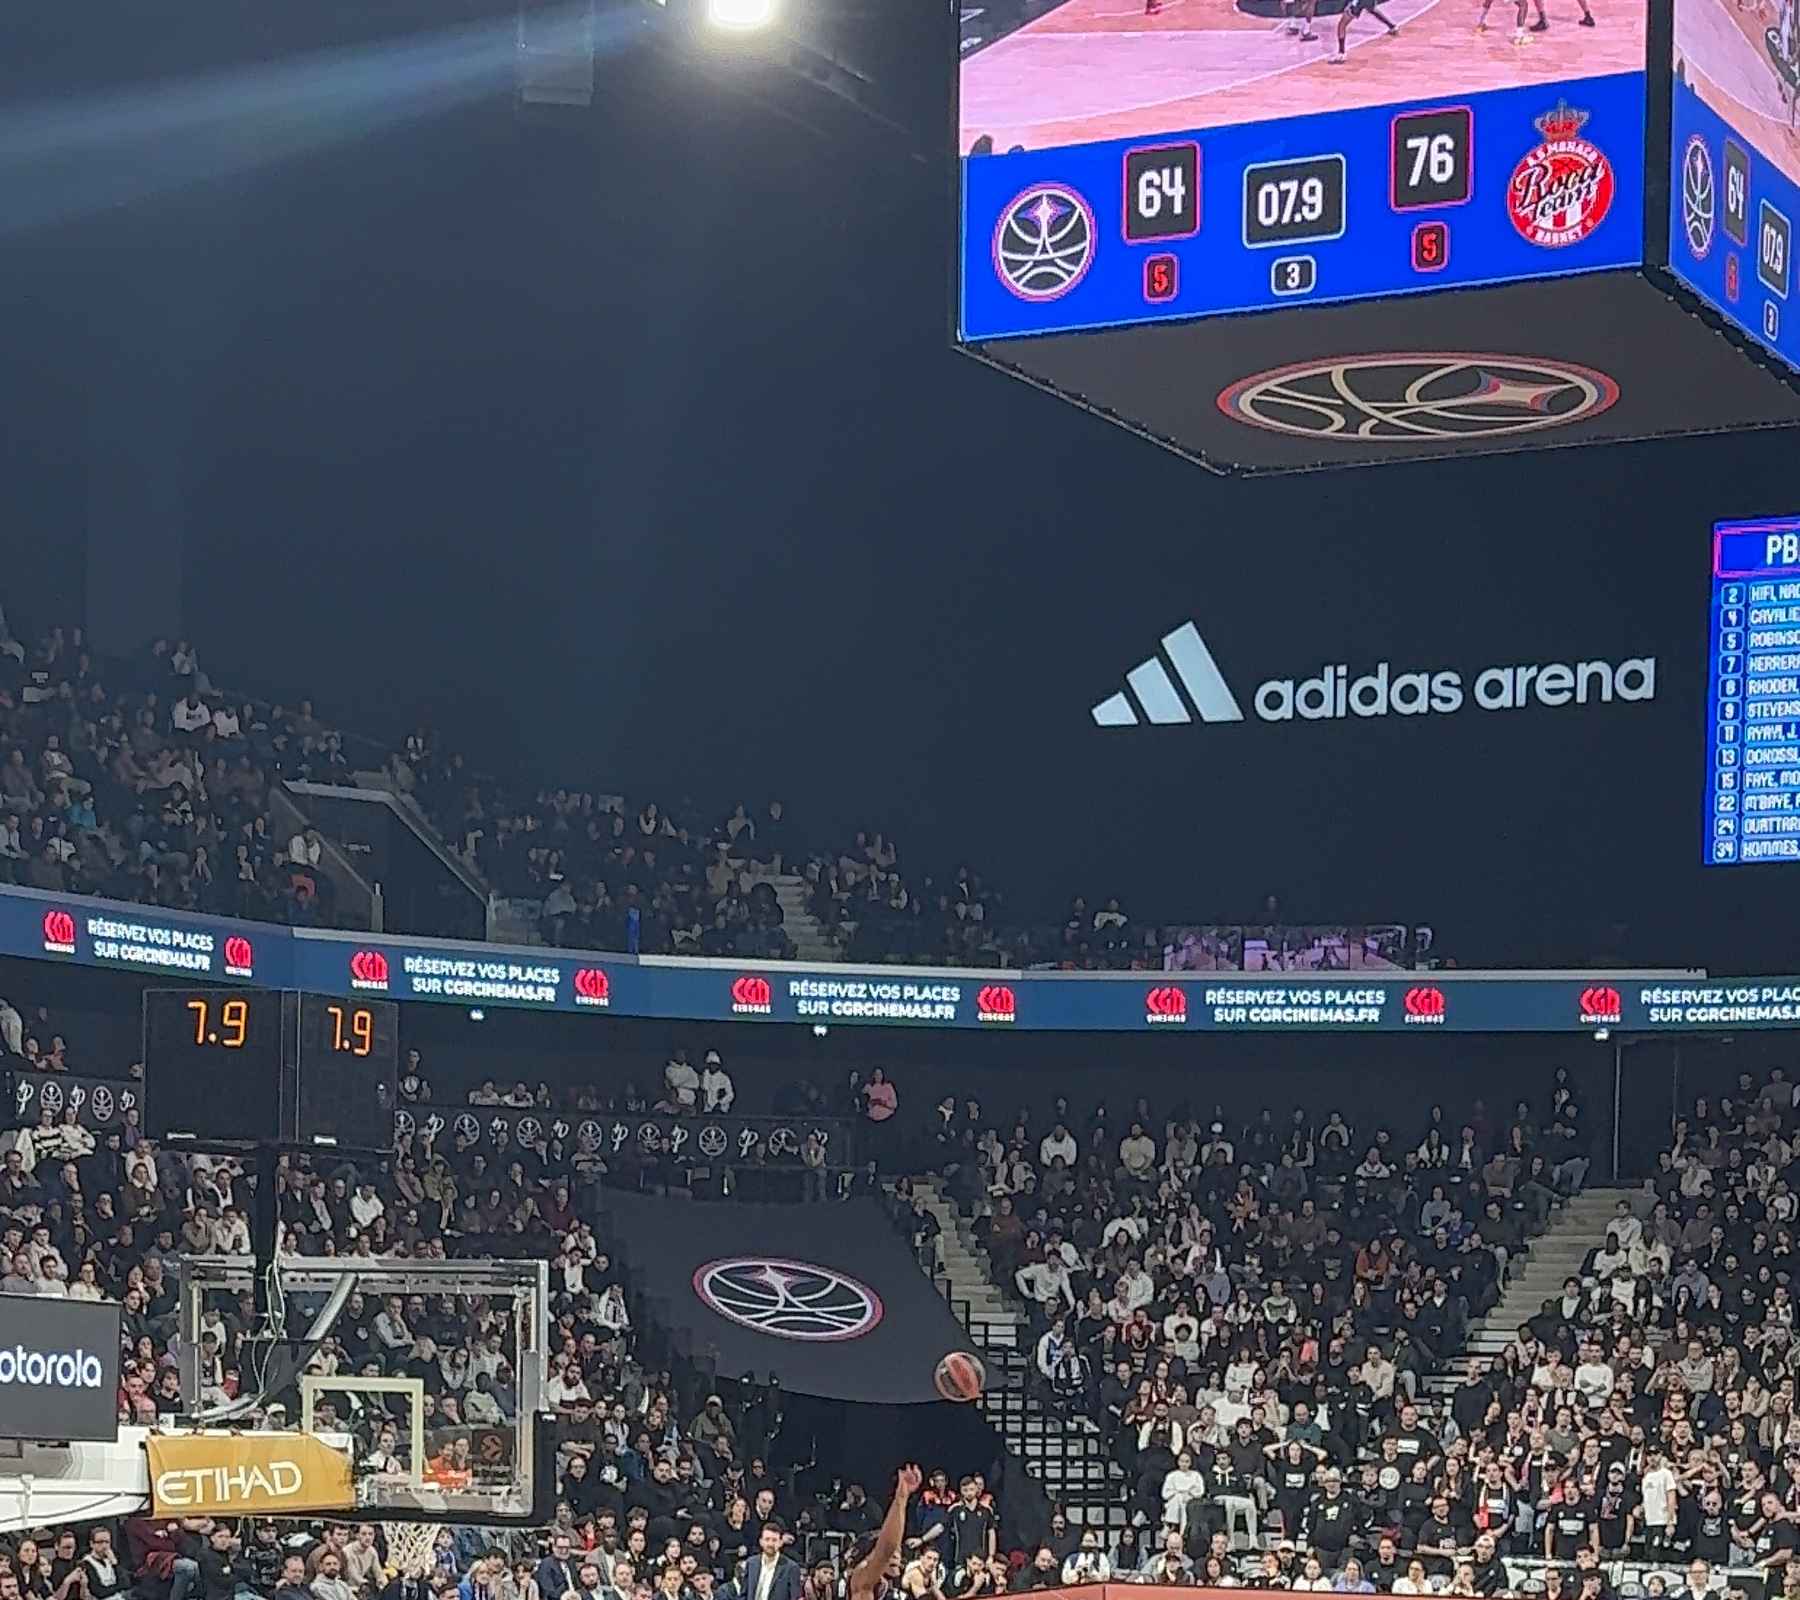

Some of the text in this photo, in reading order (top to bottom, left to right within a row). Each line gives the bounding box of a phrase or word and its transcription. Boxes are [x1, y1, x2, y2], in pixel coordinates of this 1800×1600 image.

[1405, 134, 1455, 187] 76
[1138, 166, 1186, 219] 64
[1257, 178, 1323, 227] 07.9
[1728, 165, 1744, 220] 64
[1422, 232, 1438, 261] 5
[1762, 223, 1784, 276] 07.9
[1153, 264, 1168, 293] 5
[1286, 263, 1300, 288] 3
[1766, 533, 1800, 566] PB
[1728, 587, 1739, 603] 2
[1727, 633, 1737, 649] 5
[1727, 656, 1737, 673] 7
[1254, 656, 1657, 722] adidas arena
[1724, 702, 1735, 720] 9
[1723, 724, 1735, 741] 11
[1721, 748, 1736, 766] 13
[1720, 769, 1735, 789] 15
[1745, 771, 1779, 789] FAYE,
[1719, 794, 1735, 812] 22
[1717, 816, 1800, 836] 24 OUATTAR
[1716, 842, 1734, 859] 34
[87, 917, 214, 952] RÉSERVEZ VOS PLACES
[94, 941, 119, 959] SUR
[404, 955, 560, 985] RÉSERVEZ VOS PLACES
[412, 977, 442, 994] SUR
[443, 979, 556, 1003] CGRCINEMAS.FR
[788, 979, 961, 1002] RÉSERVEZ VOS PLACES
[1205, 985, 1386, 1006] RÉSERVEZ VOS PLACES
[1640, 986, 1724, 1006] RÉSERVEZ
[1725, 988, 1759, 1004] VOS
[797, 1000, 956, 1020] SUR CGRCINEMAS.FR
[1213, 1008, 1380, 1024] SUR CGRCINEMAS.FR
[1649, 1007, 1683, 1023] SUR
[187, 1000, 248, 1047] 7.9
[326, 1005, 373, 1056] 7.9
[0, 1344, 102, 1388] otorola
[156, 1461, 303, 1506] ETIHAD
